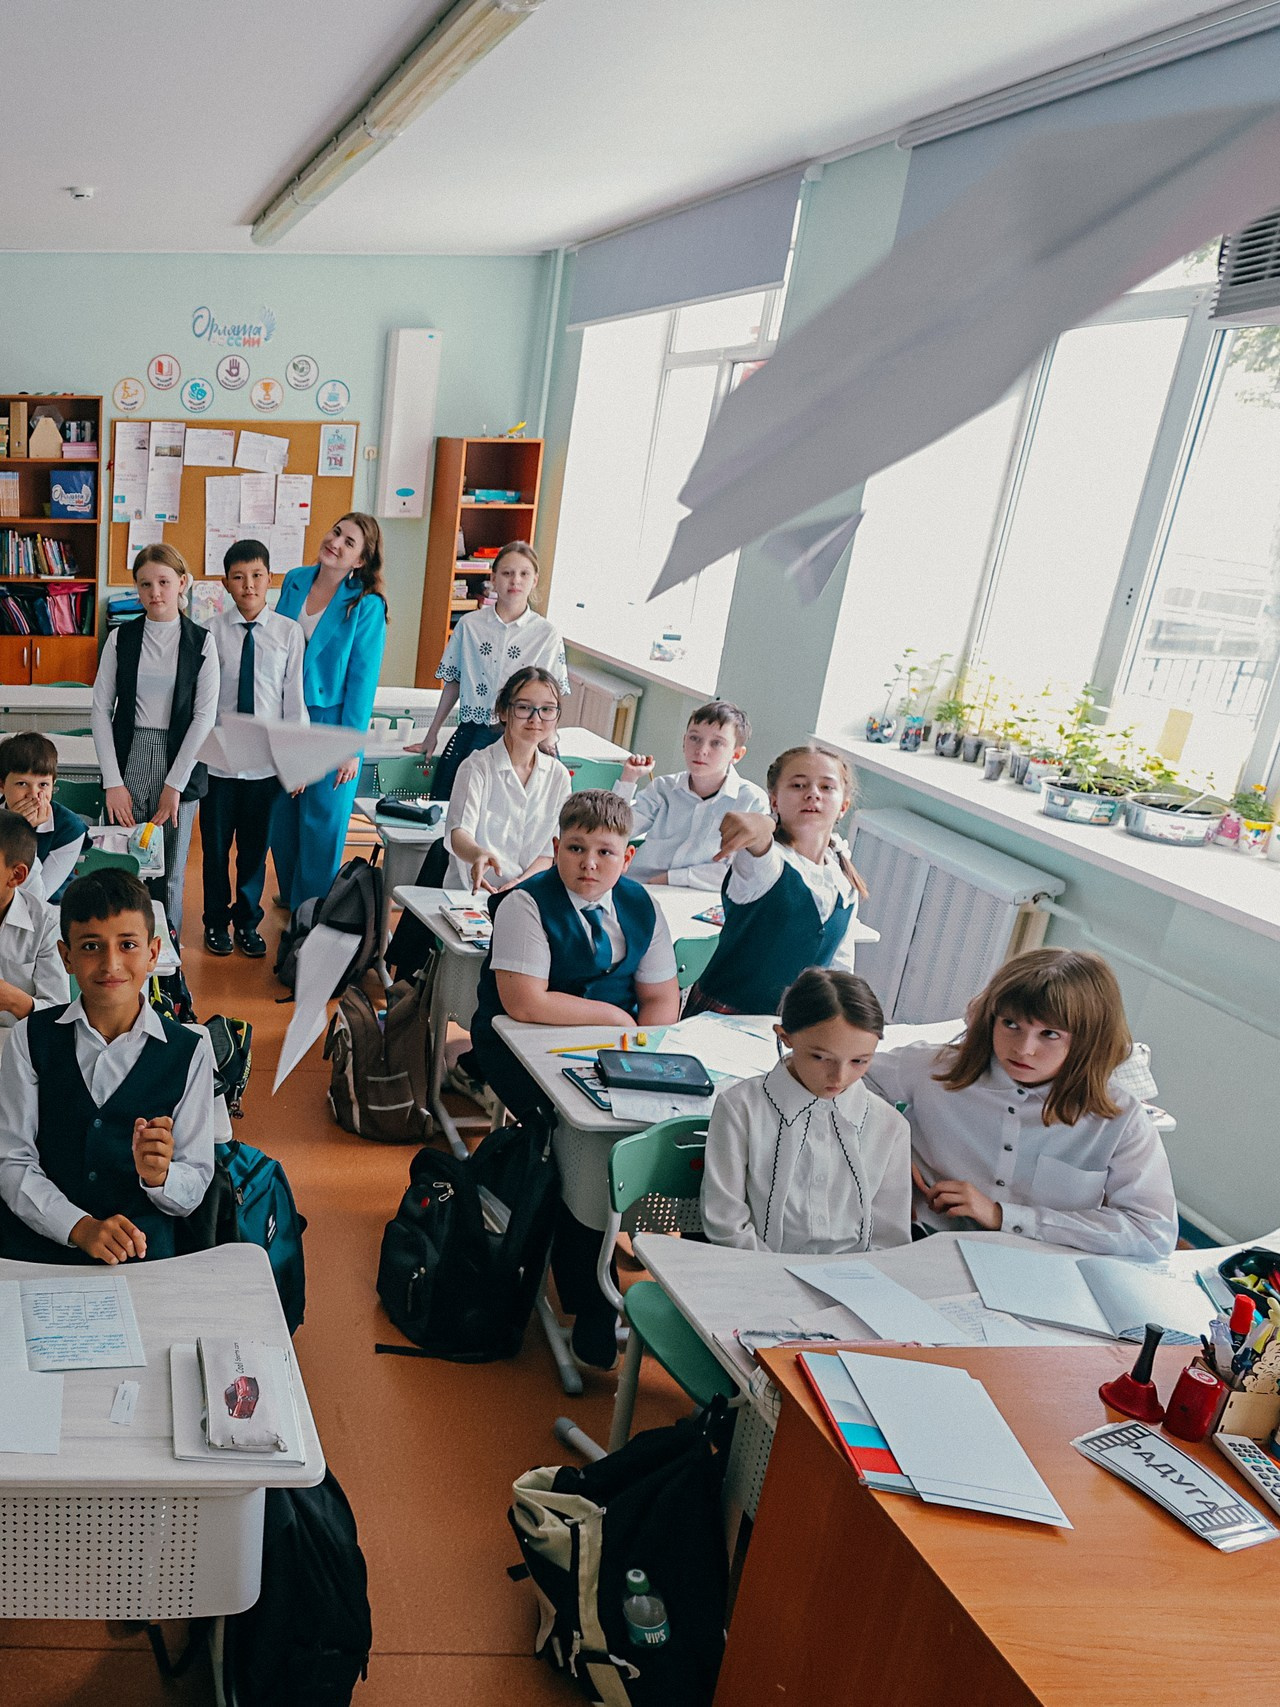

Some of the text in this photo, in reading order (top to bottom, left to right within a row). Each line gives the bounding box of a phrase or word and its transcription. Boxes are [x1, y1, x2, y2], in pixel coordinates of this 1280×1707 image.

[193, 306, 262, 341] Орлята
[1119, 1438, 1220, 1516] РАДУГА
[644, 1629, 667, 1644] VIPS
